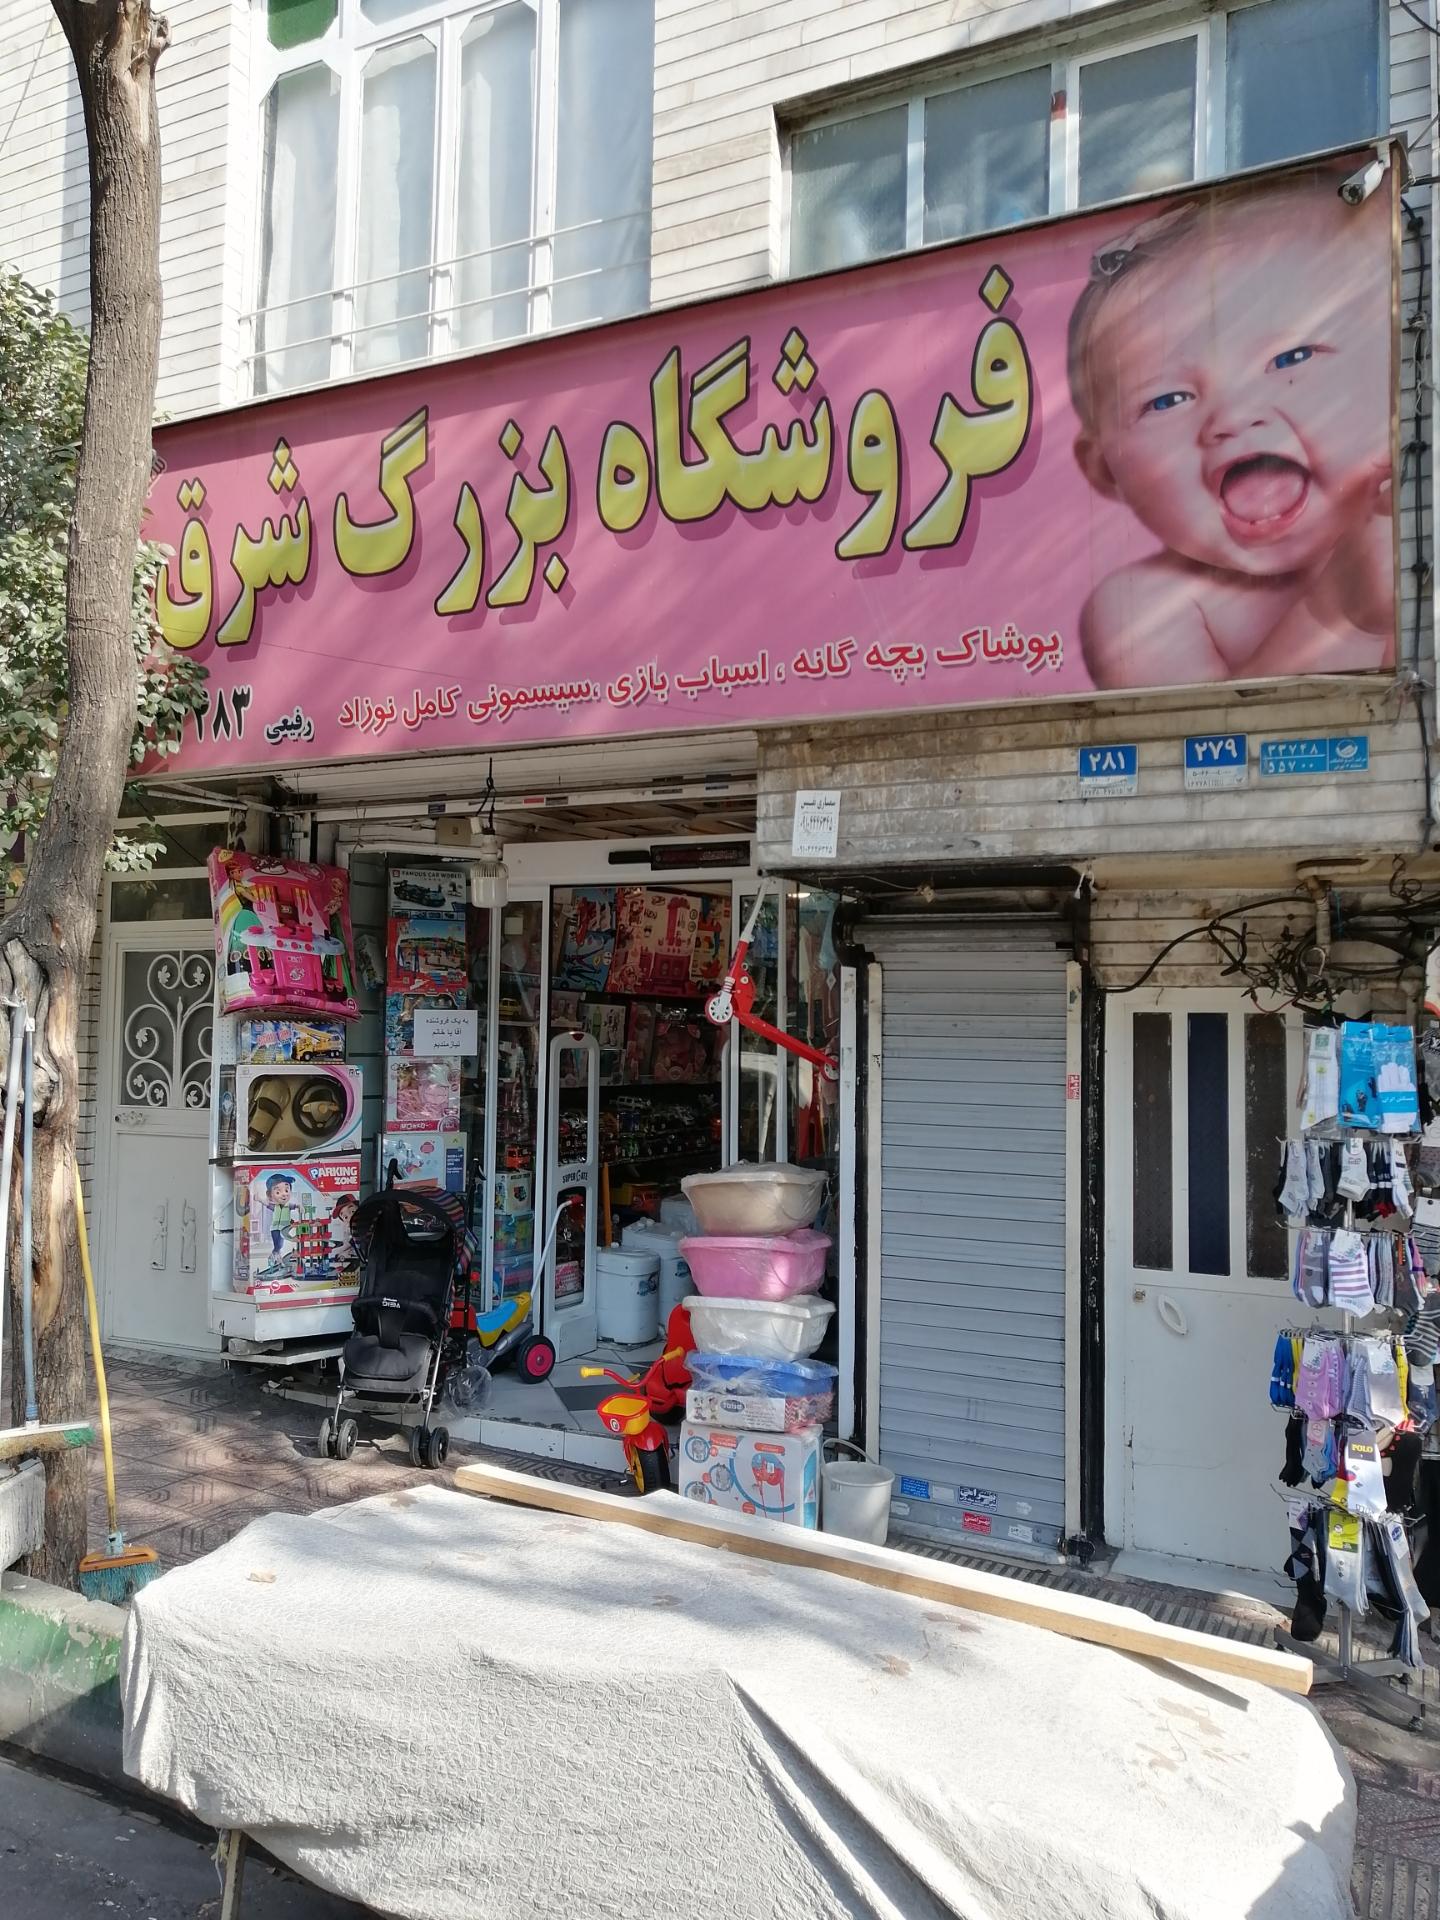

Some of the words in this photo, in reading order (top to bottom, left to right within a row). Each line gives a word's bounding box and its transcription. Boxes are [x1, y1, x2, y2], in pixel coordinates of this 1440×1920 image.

[597, 264, 1033, 560] فروشگاه
[334, 405, 570, 615] بزرگ
[155, 436, 312, 650] شرق
[791, 637, 857, 677] گانه
[864, 642, 926, 681] بچه
[935, 623, 1062, 671] پوشاک
[605, 661, 669, 705] بازی
[675, 650, 769, 699] اسباب
[265, 705, 314, 744] رفیعی
[337, 696, 397, 735] نوزاد
[402, 685, 462, 728] کامل
[1089, 751, 1125, 772] ۲۸۱
[1194, 738, 1238, 762] ۲۷۹
[1267, 760, 1315, 773] ۵۵۷۰۰
[425, 1016, 449, 1025] فروشنده
[308, 1166, 358, 1180] PARKING
[334, 1176, 358, 1186] ZONE
[562, 1172, 576, 1184] SUPER
[1351, 1443, 1374, 1454] POLO
